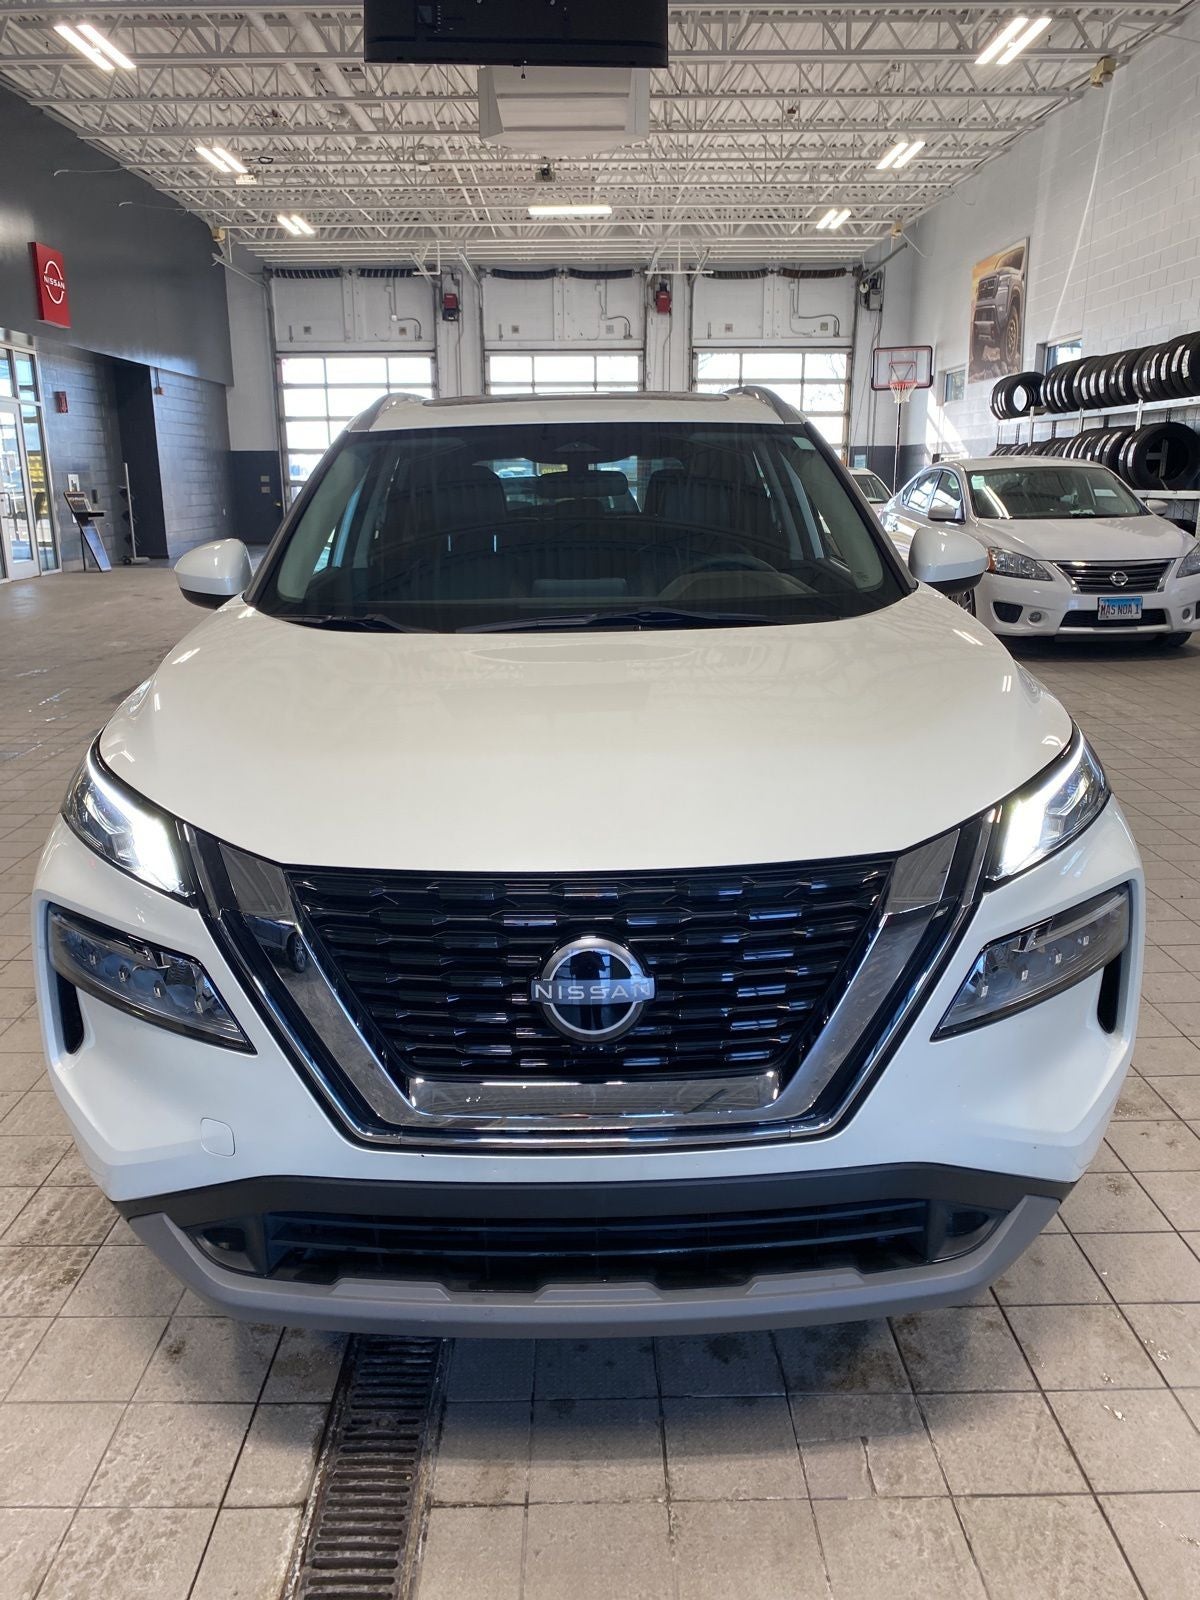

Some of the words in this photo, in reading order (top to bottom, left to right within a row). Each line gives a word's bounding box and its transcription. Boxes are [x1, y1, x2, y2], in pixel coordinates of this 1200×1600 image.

[43, 275, 65, 289] NISSAN
[1101, 604, 1115, 615] MAS
[535, 983, 651, 999] NISSAN
